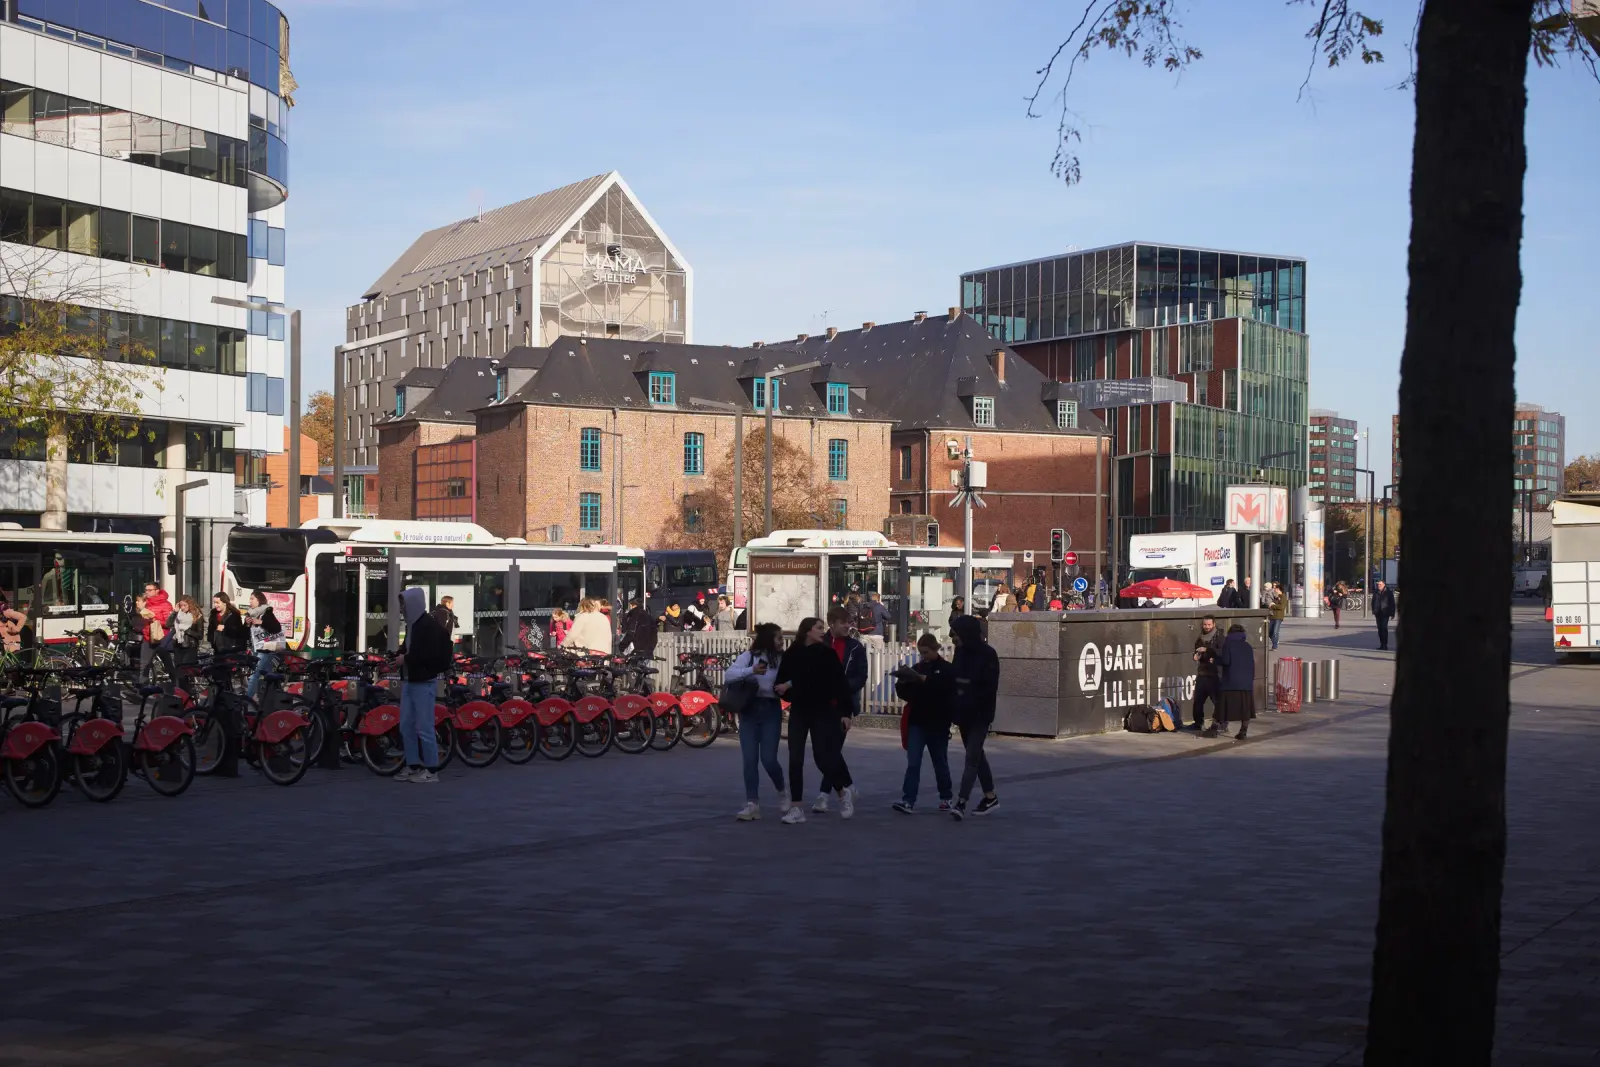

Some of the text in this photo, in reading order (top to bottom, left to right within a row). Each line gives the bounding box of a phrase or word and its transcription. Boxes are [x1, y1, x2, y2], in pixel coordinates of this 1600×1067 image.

[583, 250, 647, 274] MAMA
[593, 272, 636, 284] SHELTER
[1104, 643, 1143, 672] GARE
[1104, 678, 1145, 709] LILLE
